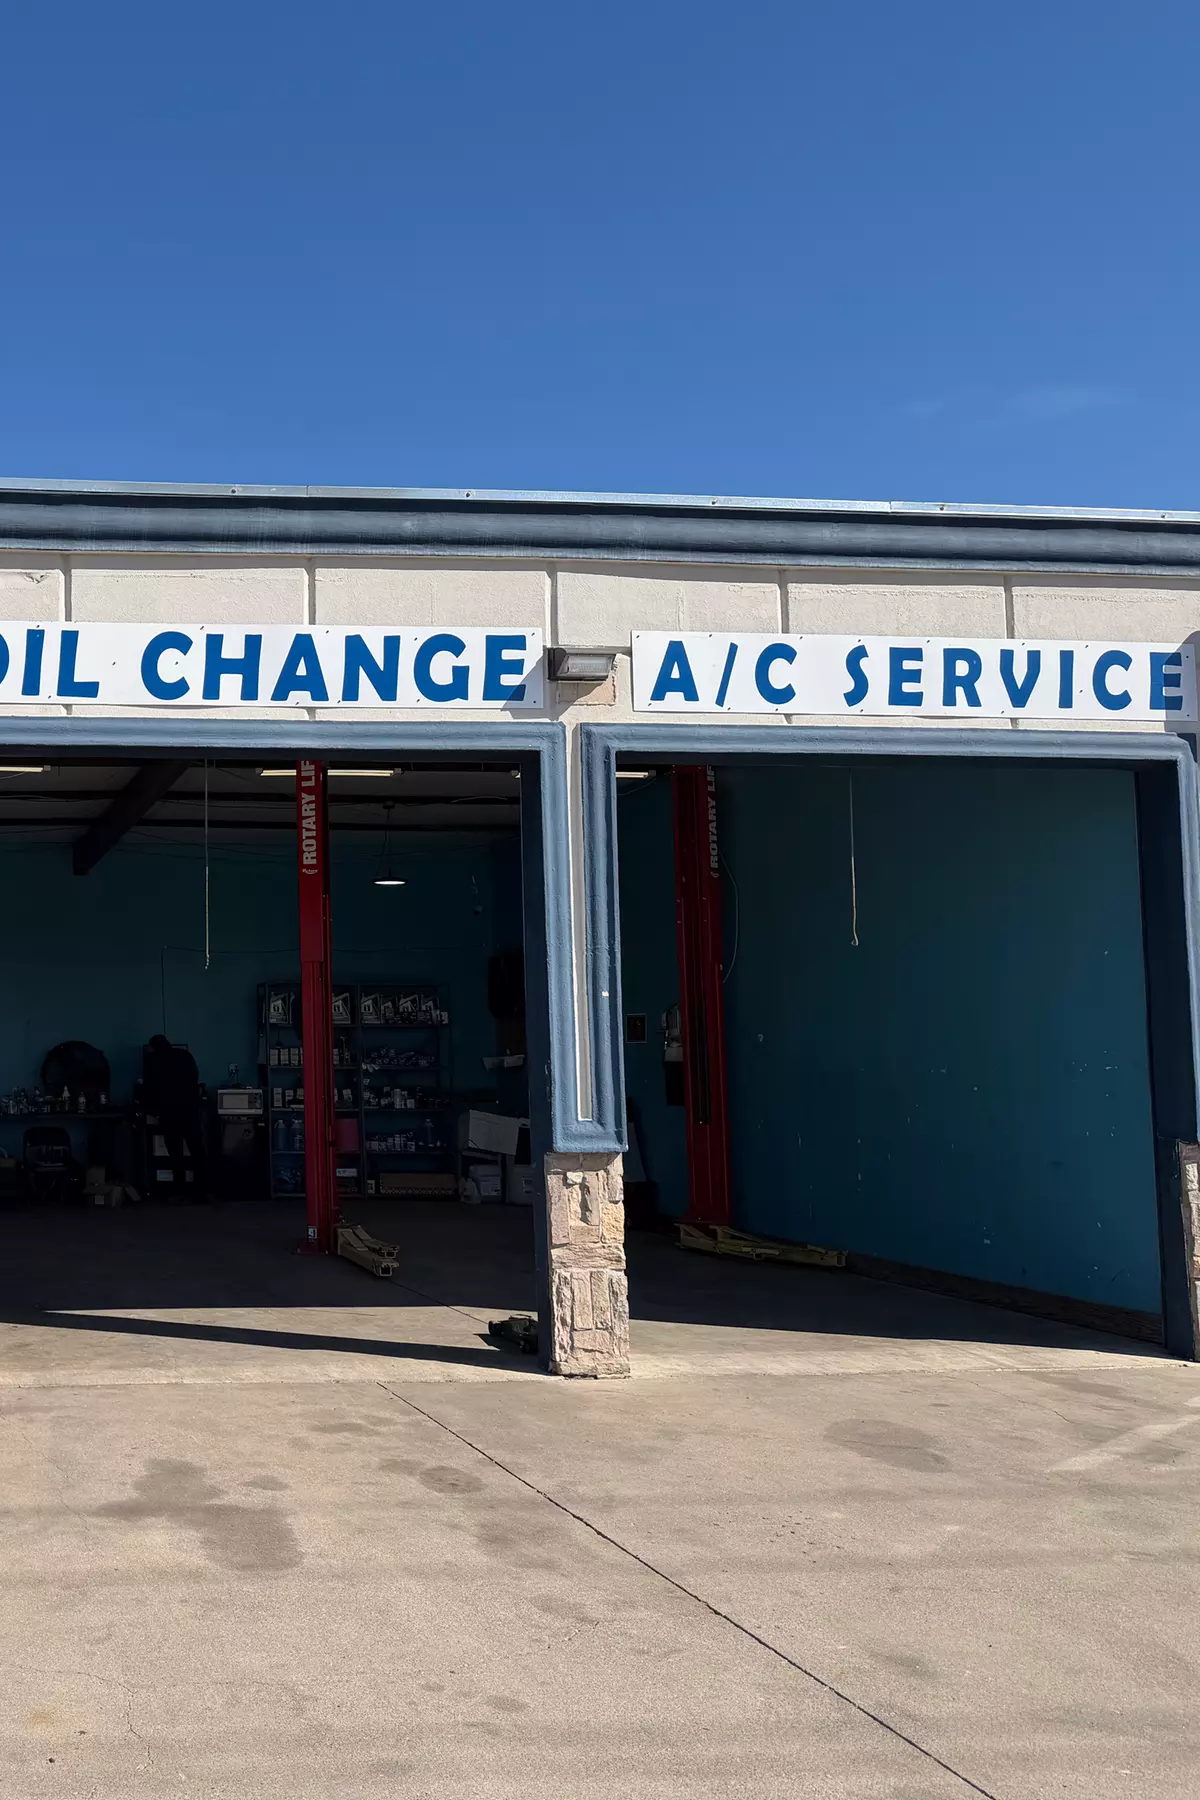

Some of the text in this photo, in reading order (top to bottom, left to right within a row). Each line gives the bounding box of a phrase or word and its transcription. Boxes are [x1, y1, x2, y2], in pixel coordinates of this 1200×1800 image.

[141, 631, 528, 702] CHANGE
[650, 641, 1184, 711] A/C SERVICE
[300, 760, 316, 787] LIF
[301, 792, 317, 865] ROTARY
[707, 796, 719, 869] ROTARY
